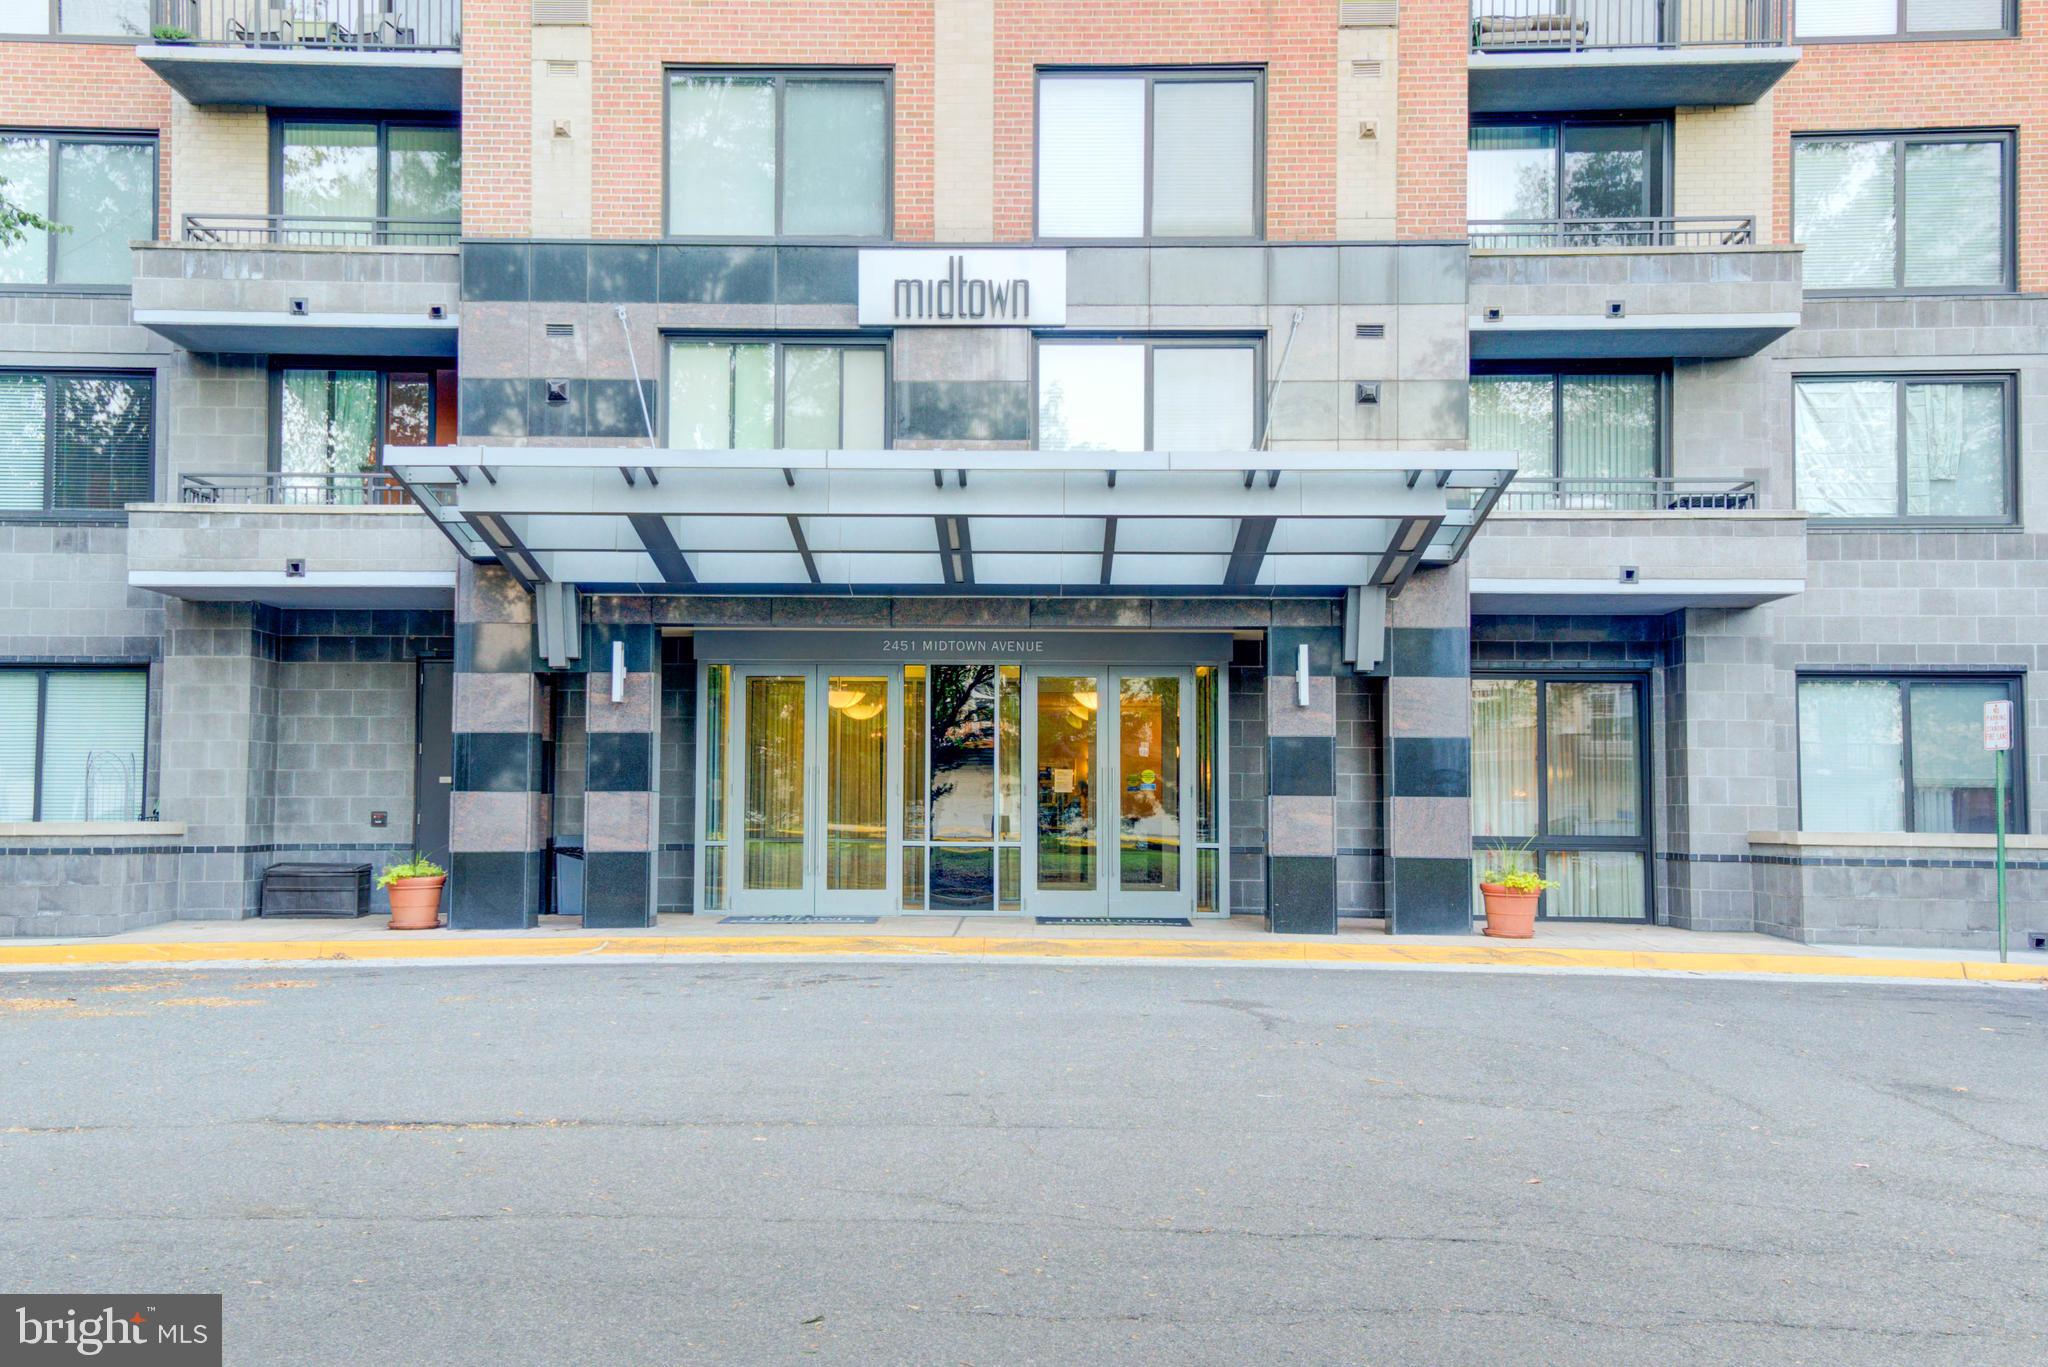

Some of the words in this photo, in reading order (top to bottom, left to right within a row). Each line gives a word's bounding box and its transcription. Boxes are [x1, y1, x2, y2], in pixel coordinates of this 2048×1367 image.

[894, 255, 1030, 319] midtown
[882, 640, 916, 651] 2451
[922, 640, 986, 651] MIDTOWN
[991, 640, 1044, 652] AVENUE
